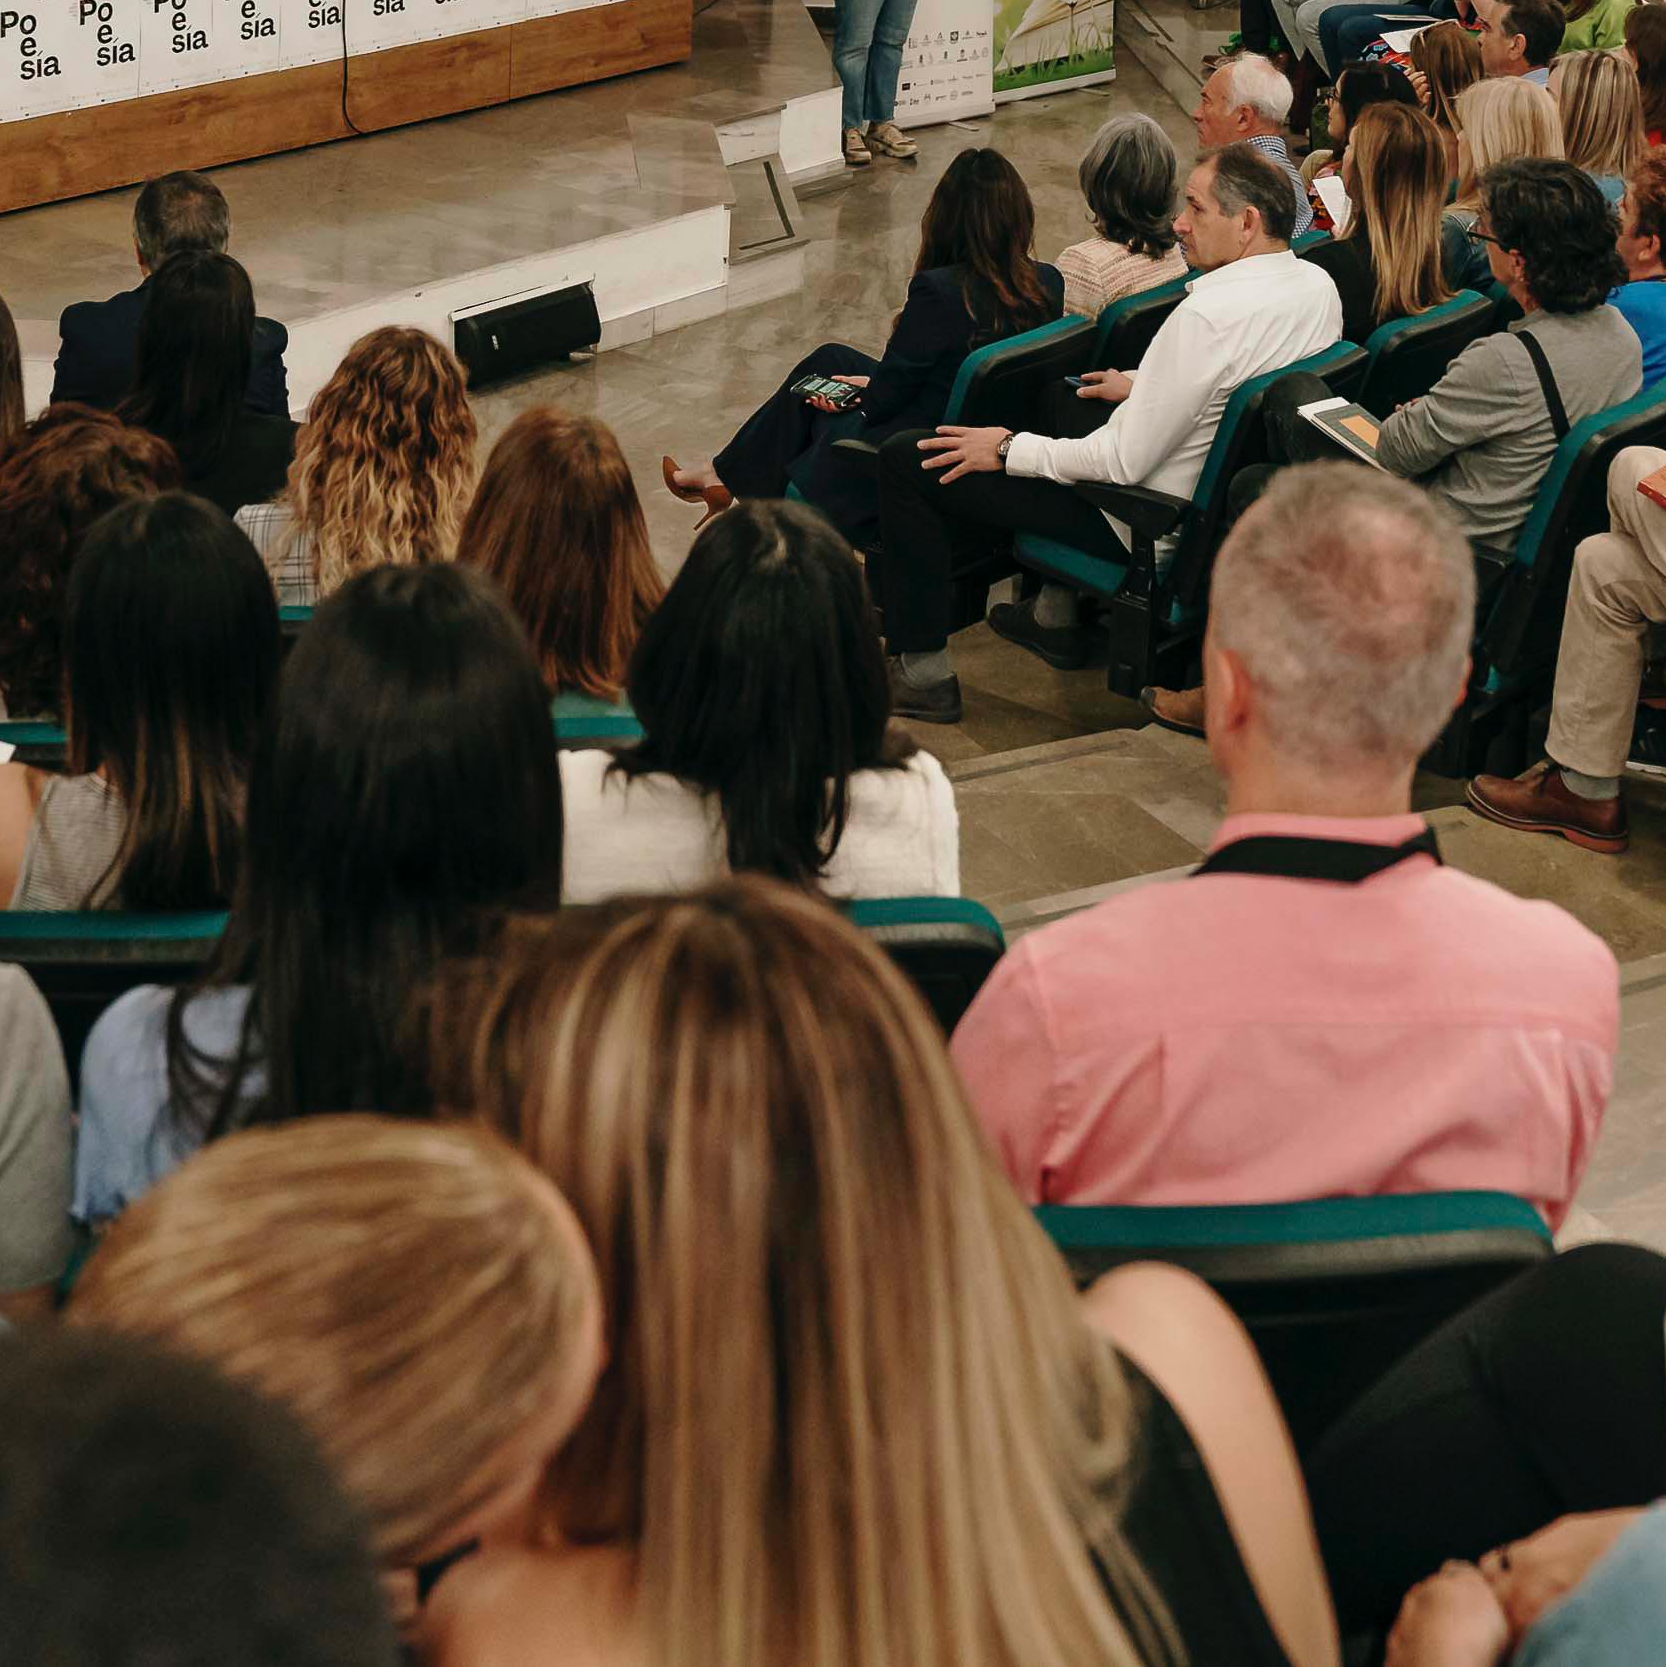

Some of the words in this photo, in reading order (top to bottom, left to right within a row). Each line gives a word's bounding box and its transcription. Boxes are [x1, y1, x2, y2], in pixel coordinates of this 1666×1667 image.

[171, 11, 187, 31] e
[241, 0, 255, 19] e
[308, 1, 341, 29] sía
[0, 10, 37, 38] Po
[97, 24, 112, 44] e
[240, 12, 276, 40] sía
[20, 36, 37, 57] e
[96, 37, 136, 66] sía
[171, 24, 209, 53] sía
[20, 50, 61, 80] sía
